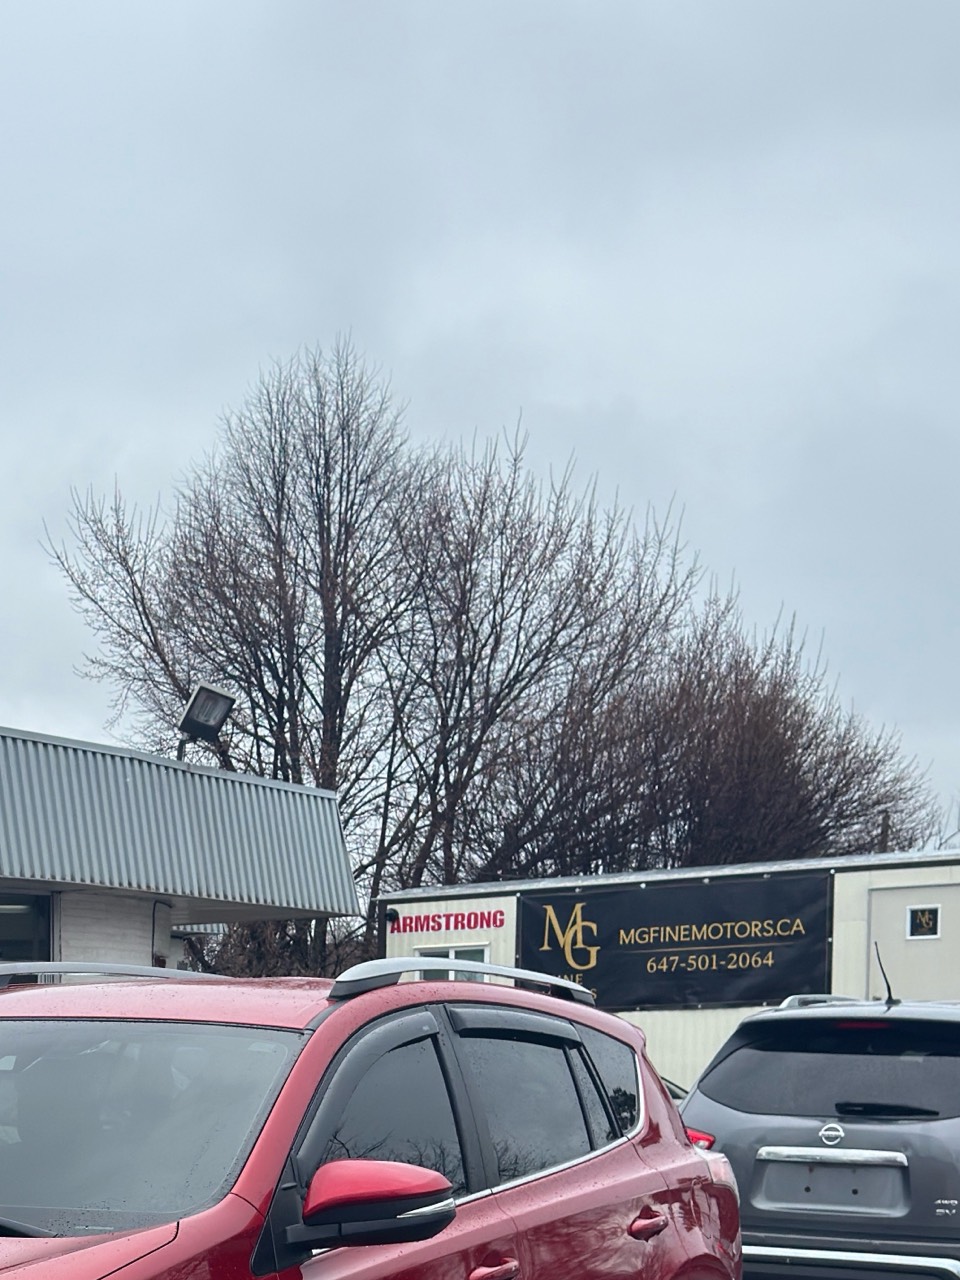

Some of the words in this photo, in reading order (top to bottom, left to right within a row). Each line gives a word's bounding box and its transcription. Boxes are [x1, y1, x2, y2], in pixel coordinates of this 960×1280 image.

[390, 910, 505, 934] ARMSTRONG
[619, 918, 805, 945] MGFINEMOTORS.CA
[646, 951, 775, 973] 647-501-2064
